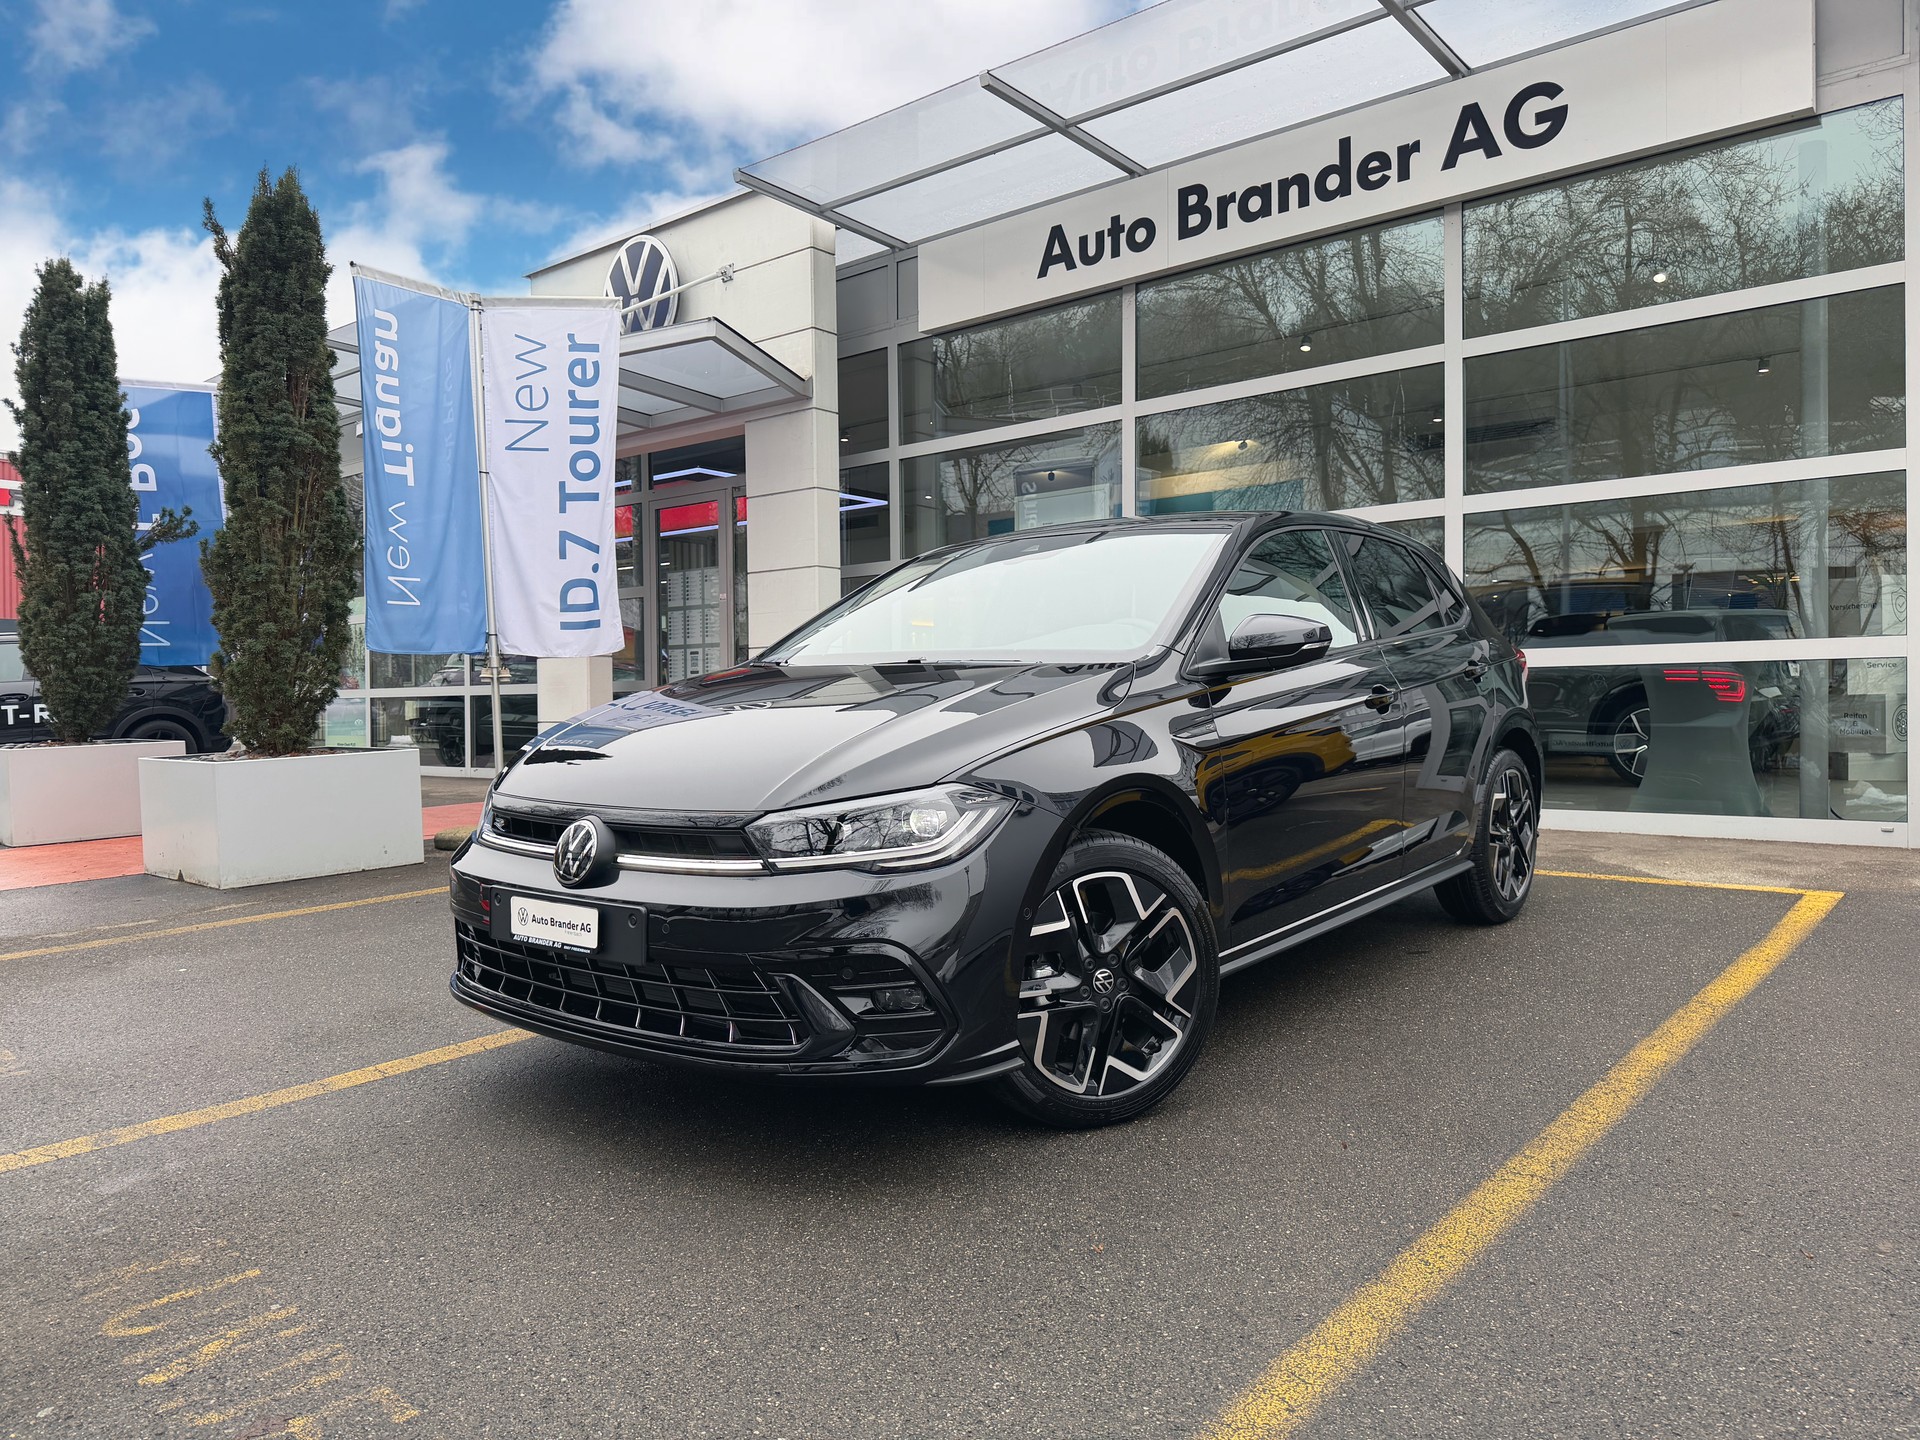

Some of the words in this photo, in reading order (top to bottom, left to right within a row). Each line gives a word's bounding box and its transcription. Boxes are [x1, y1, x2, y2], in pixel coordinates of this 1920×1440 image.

[1036, 214, 1157, 280] Auto
[1177, 136, 1421, 241] Brander
[1440, 81, 1569, 172] AG
[505, 333, 550, 452] New
[558, 332, 601, 514] Tourer
[558, 530, 601, 631] ID.7
[1829, 602, 1878, 611] Versicherung
[1866, 661, 1898, 669] Service
[513, 934, 528, 942] AUTO
[528, 936, 553, 947] BRANDER
[554, 941, 562, 949] AG
[531, 914, 549, 926] Auto
[550, 917, 579, 931] Brander
[579, 923, 592, 933] AG
